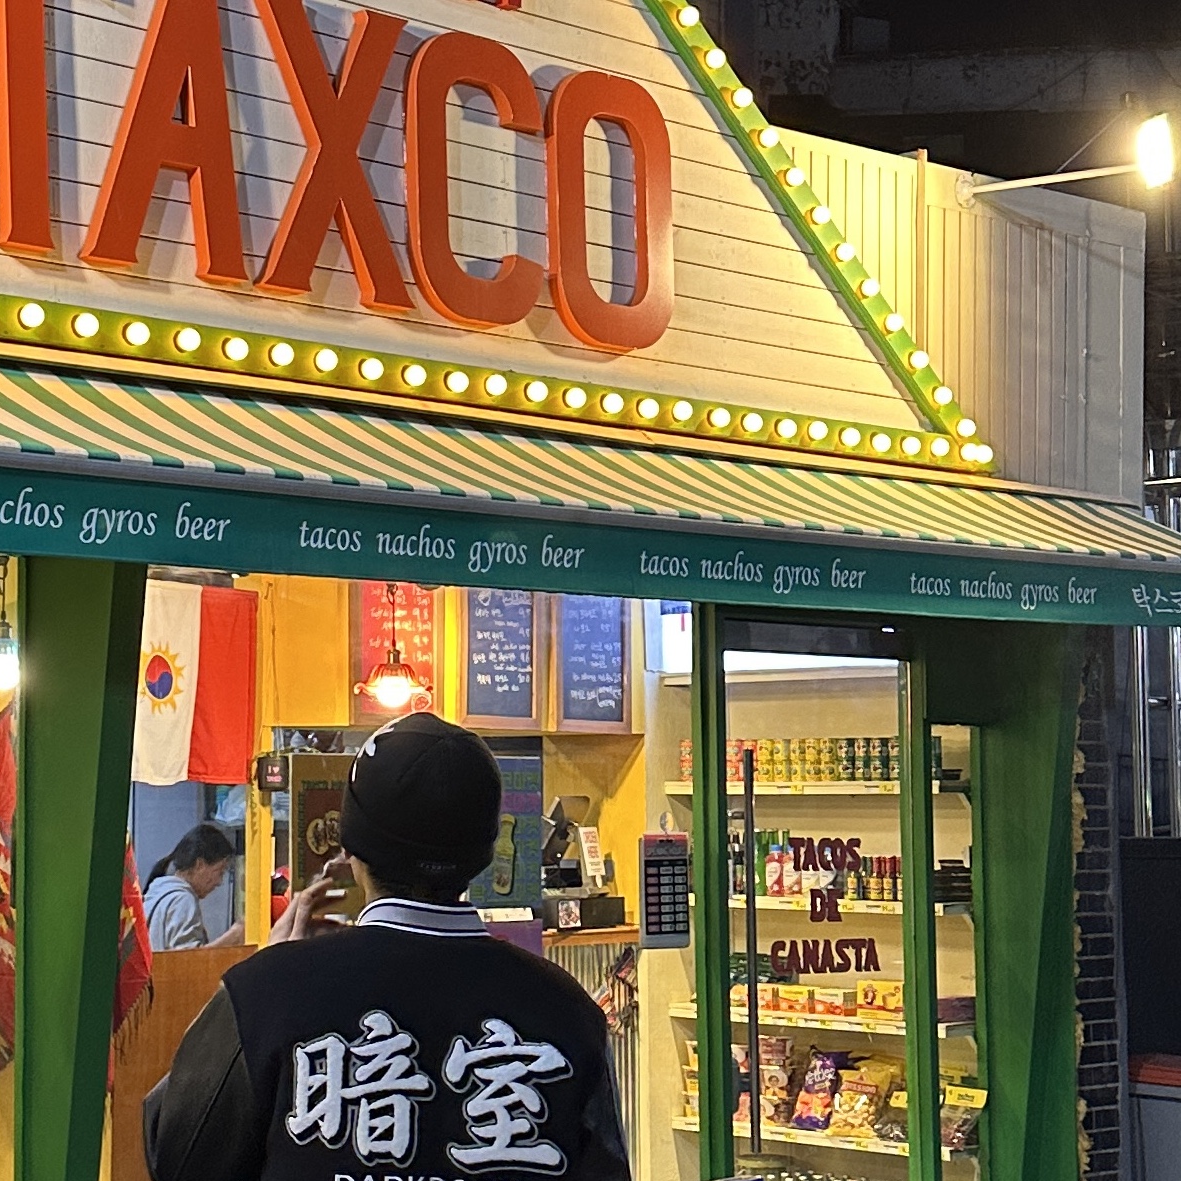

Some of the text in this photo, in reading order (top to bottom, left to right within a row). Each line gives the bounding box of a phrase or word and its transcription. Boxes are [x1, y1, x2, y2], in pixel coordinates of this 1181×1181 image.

[79, 506, 158, 544] gyros
[175, 502, 230, 541] beer
[300, 520, 585, 573] tacos nachos gyros beer
[640, 550, 866, 594] tacos nachos gyros beer
[910, 571, 1097, 610] tacos nachos gyros beer
[788, 837, 861, 872] TACOS
[809, 888, 843, 923] DE
[770, 938, 881, 975] CANASTA
[287, 1010, 572, 1175] 暗室
